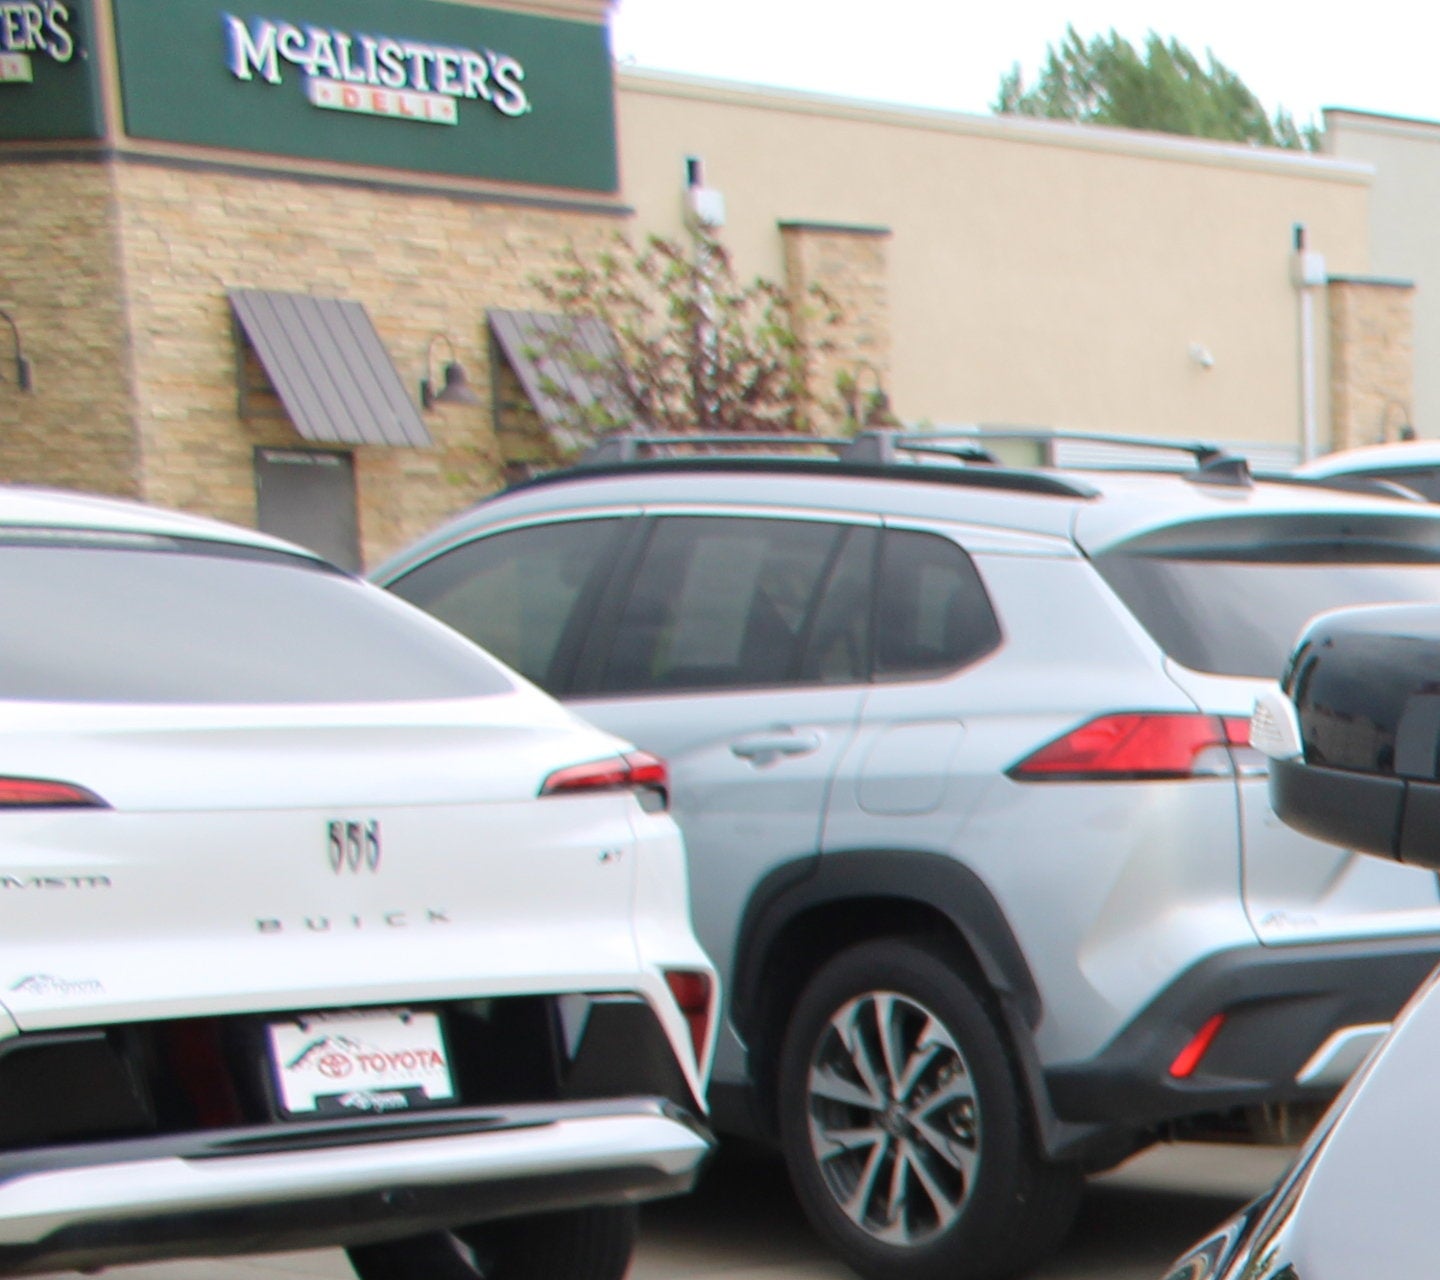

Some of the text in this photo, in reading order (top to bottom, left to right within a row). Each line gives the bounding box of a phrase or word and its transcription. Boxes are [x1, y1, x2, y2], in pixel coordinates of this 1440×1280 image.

[341, 88, 434, 118] DELI
[255, 907, 451, 934] BUICK
[356, 1050, 445, 1073] TOYOTA
